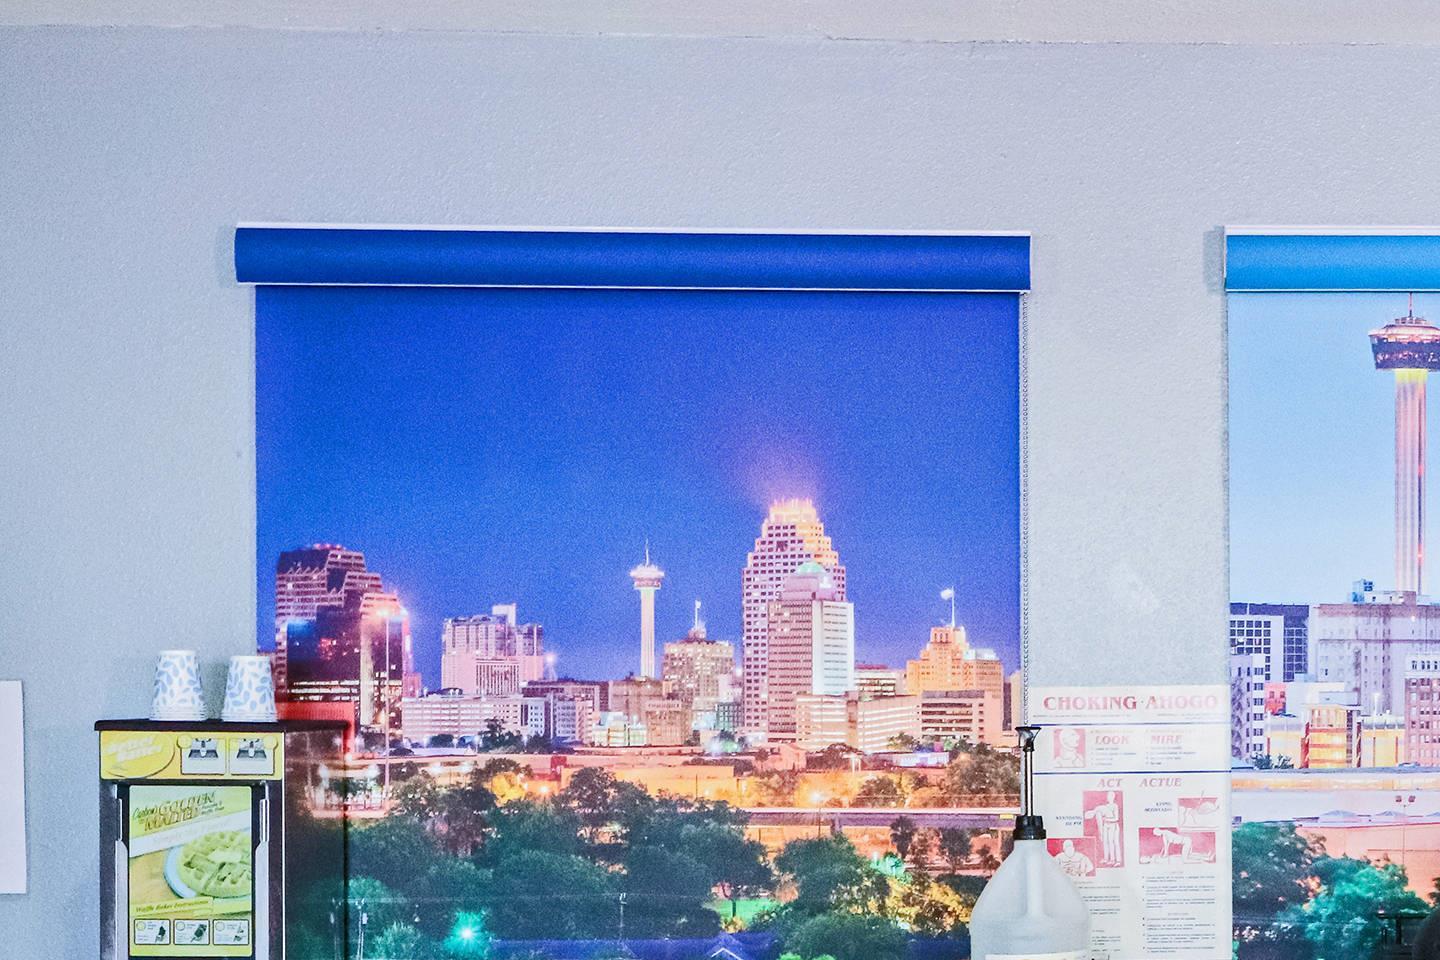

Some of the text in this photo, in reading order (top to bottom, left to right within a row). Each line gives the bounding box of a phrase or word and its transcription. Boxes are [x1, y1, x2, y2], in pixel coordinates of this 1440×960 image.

[1043, 694, 1219, 711] CHOKING AHOGO
[1095, 735, 1183, 745] LOOK MIRE
[1096, 777, 1183, 788] ACT ACTUE
